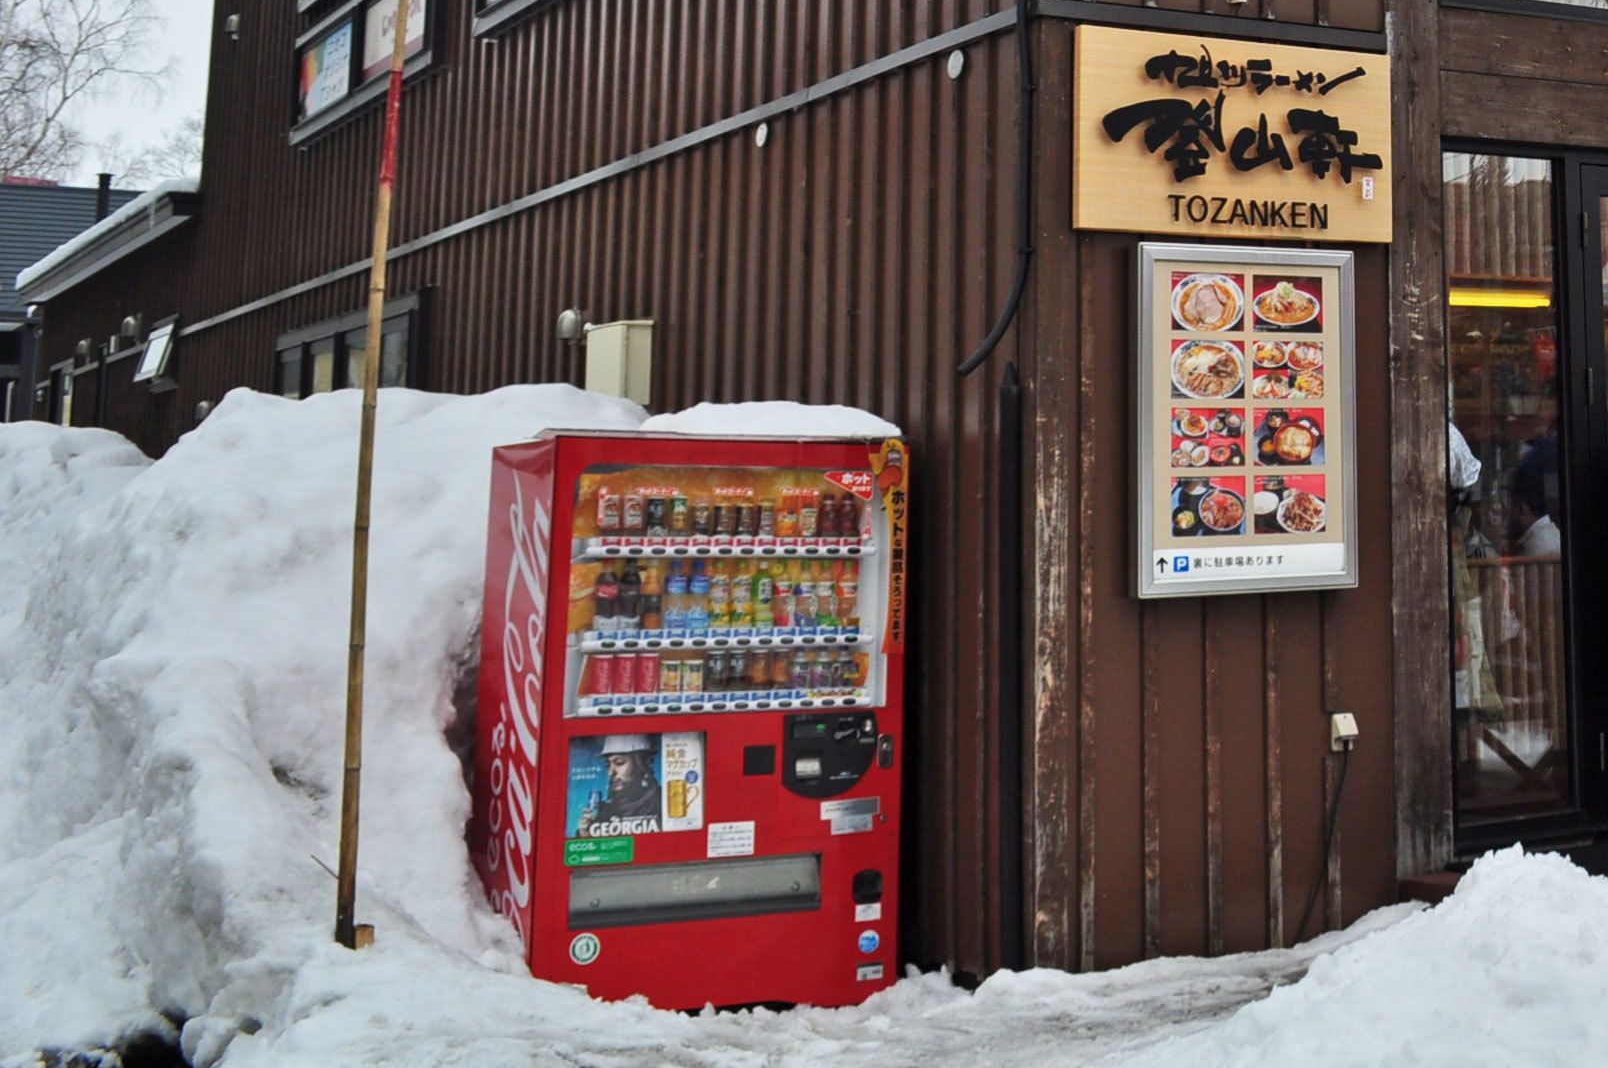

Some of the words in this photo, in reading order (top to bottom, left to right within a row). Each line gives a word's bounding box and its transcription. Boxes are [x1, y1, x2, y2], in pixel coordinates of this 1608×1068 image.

[1167, 194, 1329, 230] TOZANKEN
[502, 469, 551, 932] oca-Cola
[589, 818, 660, 837] GEORGIA
